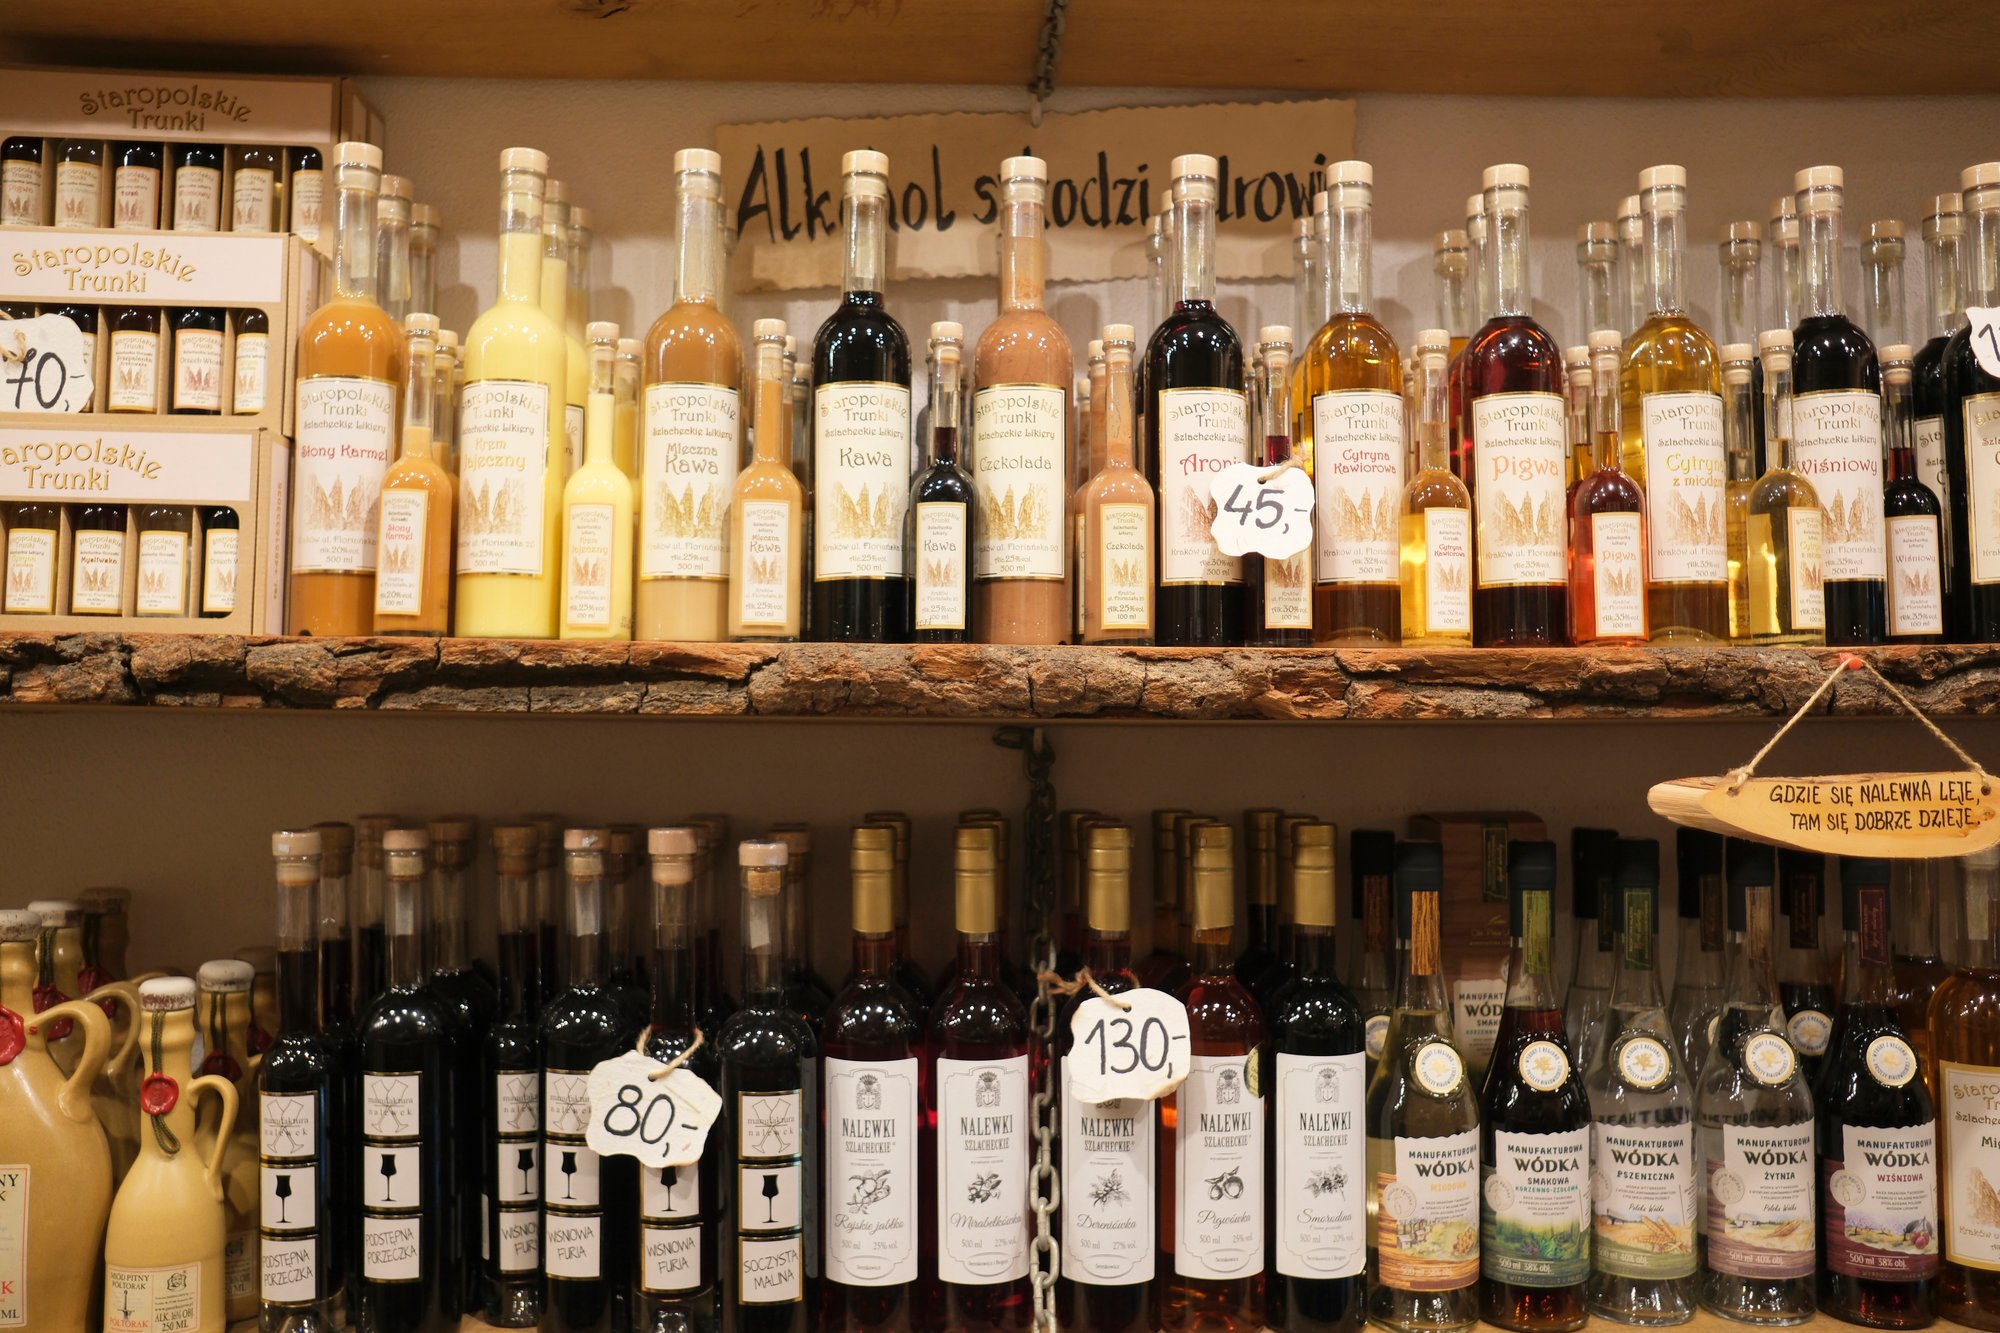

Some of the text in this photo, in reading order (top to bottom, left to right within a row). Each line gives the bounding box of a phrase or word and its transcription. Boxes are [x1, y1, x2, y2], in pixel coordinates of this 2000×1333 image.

[79, 84, 252, 123] Staropolskie
[127, 107, 205, 131] Trunki
[12, 241, 196, 282] Staropolskie
[62, 267, 147, 292] Trunki
[323, 402, 367, 416] Trunki
[672, 408, 716, 423] Trunki
[844, 408, 888, 422] Trunki
[995, 411, 1036, 424] Trunki
[1344, 415, 1388, 430] Trunki
[1505, 418, 1547, 432] Trunki
[1815, 417, 1861, 430] Trunki
[1025, 429, 1055, 441] Likiery
[1173, 433, 1226, 442] Szlacheckie
[1325, 434, 1376, 442] Szlacheckie
[1485, 439, 1537, 448] Szlacheckie
[839, 447, 893, 468] Kawa
[979, 455, 1052, 472] Czekolada
[1342, 449, 1390, 464] Cytryna
[665, 453, 719, 476] Kawa
[1334, 463, 1397, 475] Kawiorowa
[1492, 455, 1559, 481] Pigwa
[1797, 457, 1878, 476] Wiśniowy
[22, 465, 109, 490] Trunki
[1223, 484, 1308, 535] 45,-
[750, 541, 781, 553] Kawa
[923, 540, 957, 552] Kawa
[1602, 551, 1637, 563] Pigwa
[1770, 785, 1820, 804] GDZIE
[1830, 785, 1853, 806] SIĘ
[1860, 780, 1932, 804] NALEWKA
[1790, 813, 1820, 831] TAM
[1827, 813, 1849, 834] SIĘ
[1855, 811, 1913, 830] DOBRZE
[1084, 1017, 1187, 1080] 130,-
[604, 1084, 699, 1158] 80,-
[842, 1118, 896, 1138] NALEWKI
[960, 1114, 1014, 1136] NALEWKI
[1081, 1117, 1135, 1138] NALEWKI
[1200, 1111, 1252, 1132] NALEWKI
[1300, 1111, 1352, 1132] NALEWKI
[845, 1140, 892, 1153] SZLACHECKIE
[964, 1137, 1010, 1151] SZLACHECKIE
[1084, 1140, 1131, 1152] SZLACHECKIE
[1204, 1135, 1249, 1148] SZLACHECKIE
[1303, 1134, 1348, 1147] SZLACHECKIE
[1606, 1136, 1684, 1148] MANUFAKTUROWA
[1737, 1136, 1811, 1148] MANUFAKTUROWA
[1857, 1138, 1932, 1149] MANUFAKTUROWA
[1409, 1145, 1477, 1159] MANUFAKTUROWA
[1507, 1144, 1583, 1155] MANUFAKTUROWA
[1514, 1157, 1580, 1173] WÓDKA
[1611, 1149, 1680, 1167] WÓDKA
[1743, 1149, 1808, 1166] WÓDKA
[1864, 1151, 1930, 1168] WÓDKA
[1415, 1158, 1475, 1178] WÓDKA
[1617, 1170, 1675, 1181] PSZENICZNA
[1764, 1170, 1796, 1181] ŻYTNIA
[1527, 1177, 1569, 1185] SMAKOWA
[1877, 1173, 1923, 1183] WIŚNIOWA
[743, 1249, 799, 1275] SOCZYSTA
[1850, 1254, 1864, 1264] 500
[1865, 1255, 1875, 1265] ml
[753, 1269, 795, 1291] MALINA
